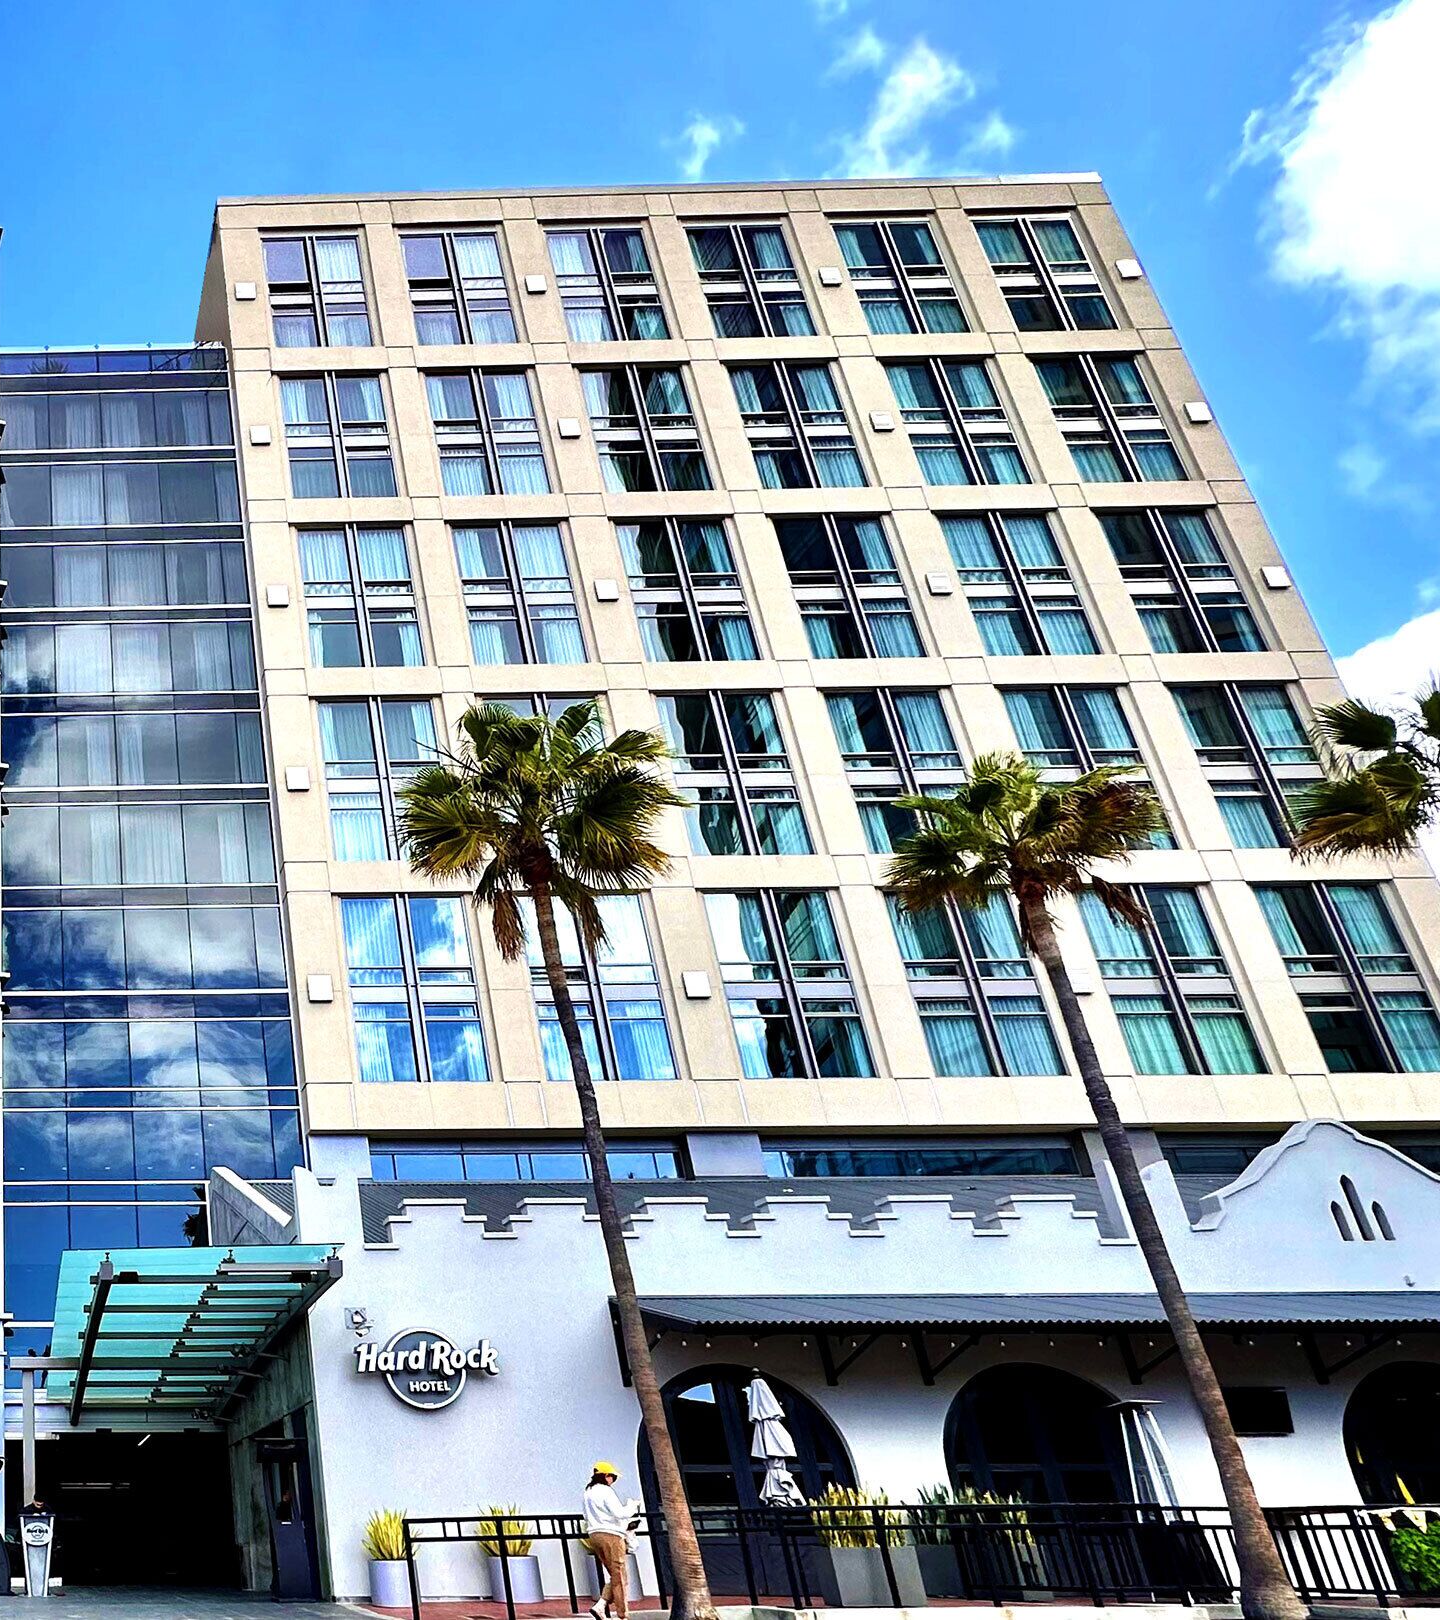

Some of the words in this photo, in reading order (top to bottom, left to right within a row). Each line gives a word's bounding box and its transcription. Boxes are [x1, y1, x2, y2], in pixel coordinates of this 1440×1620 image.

[356, 1340, 428, 1373] Hard
[430, 1338, 500, 1376] Rock
[409, 1380, 452, 1392] HOTEL
